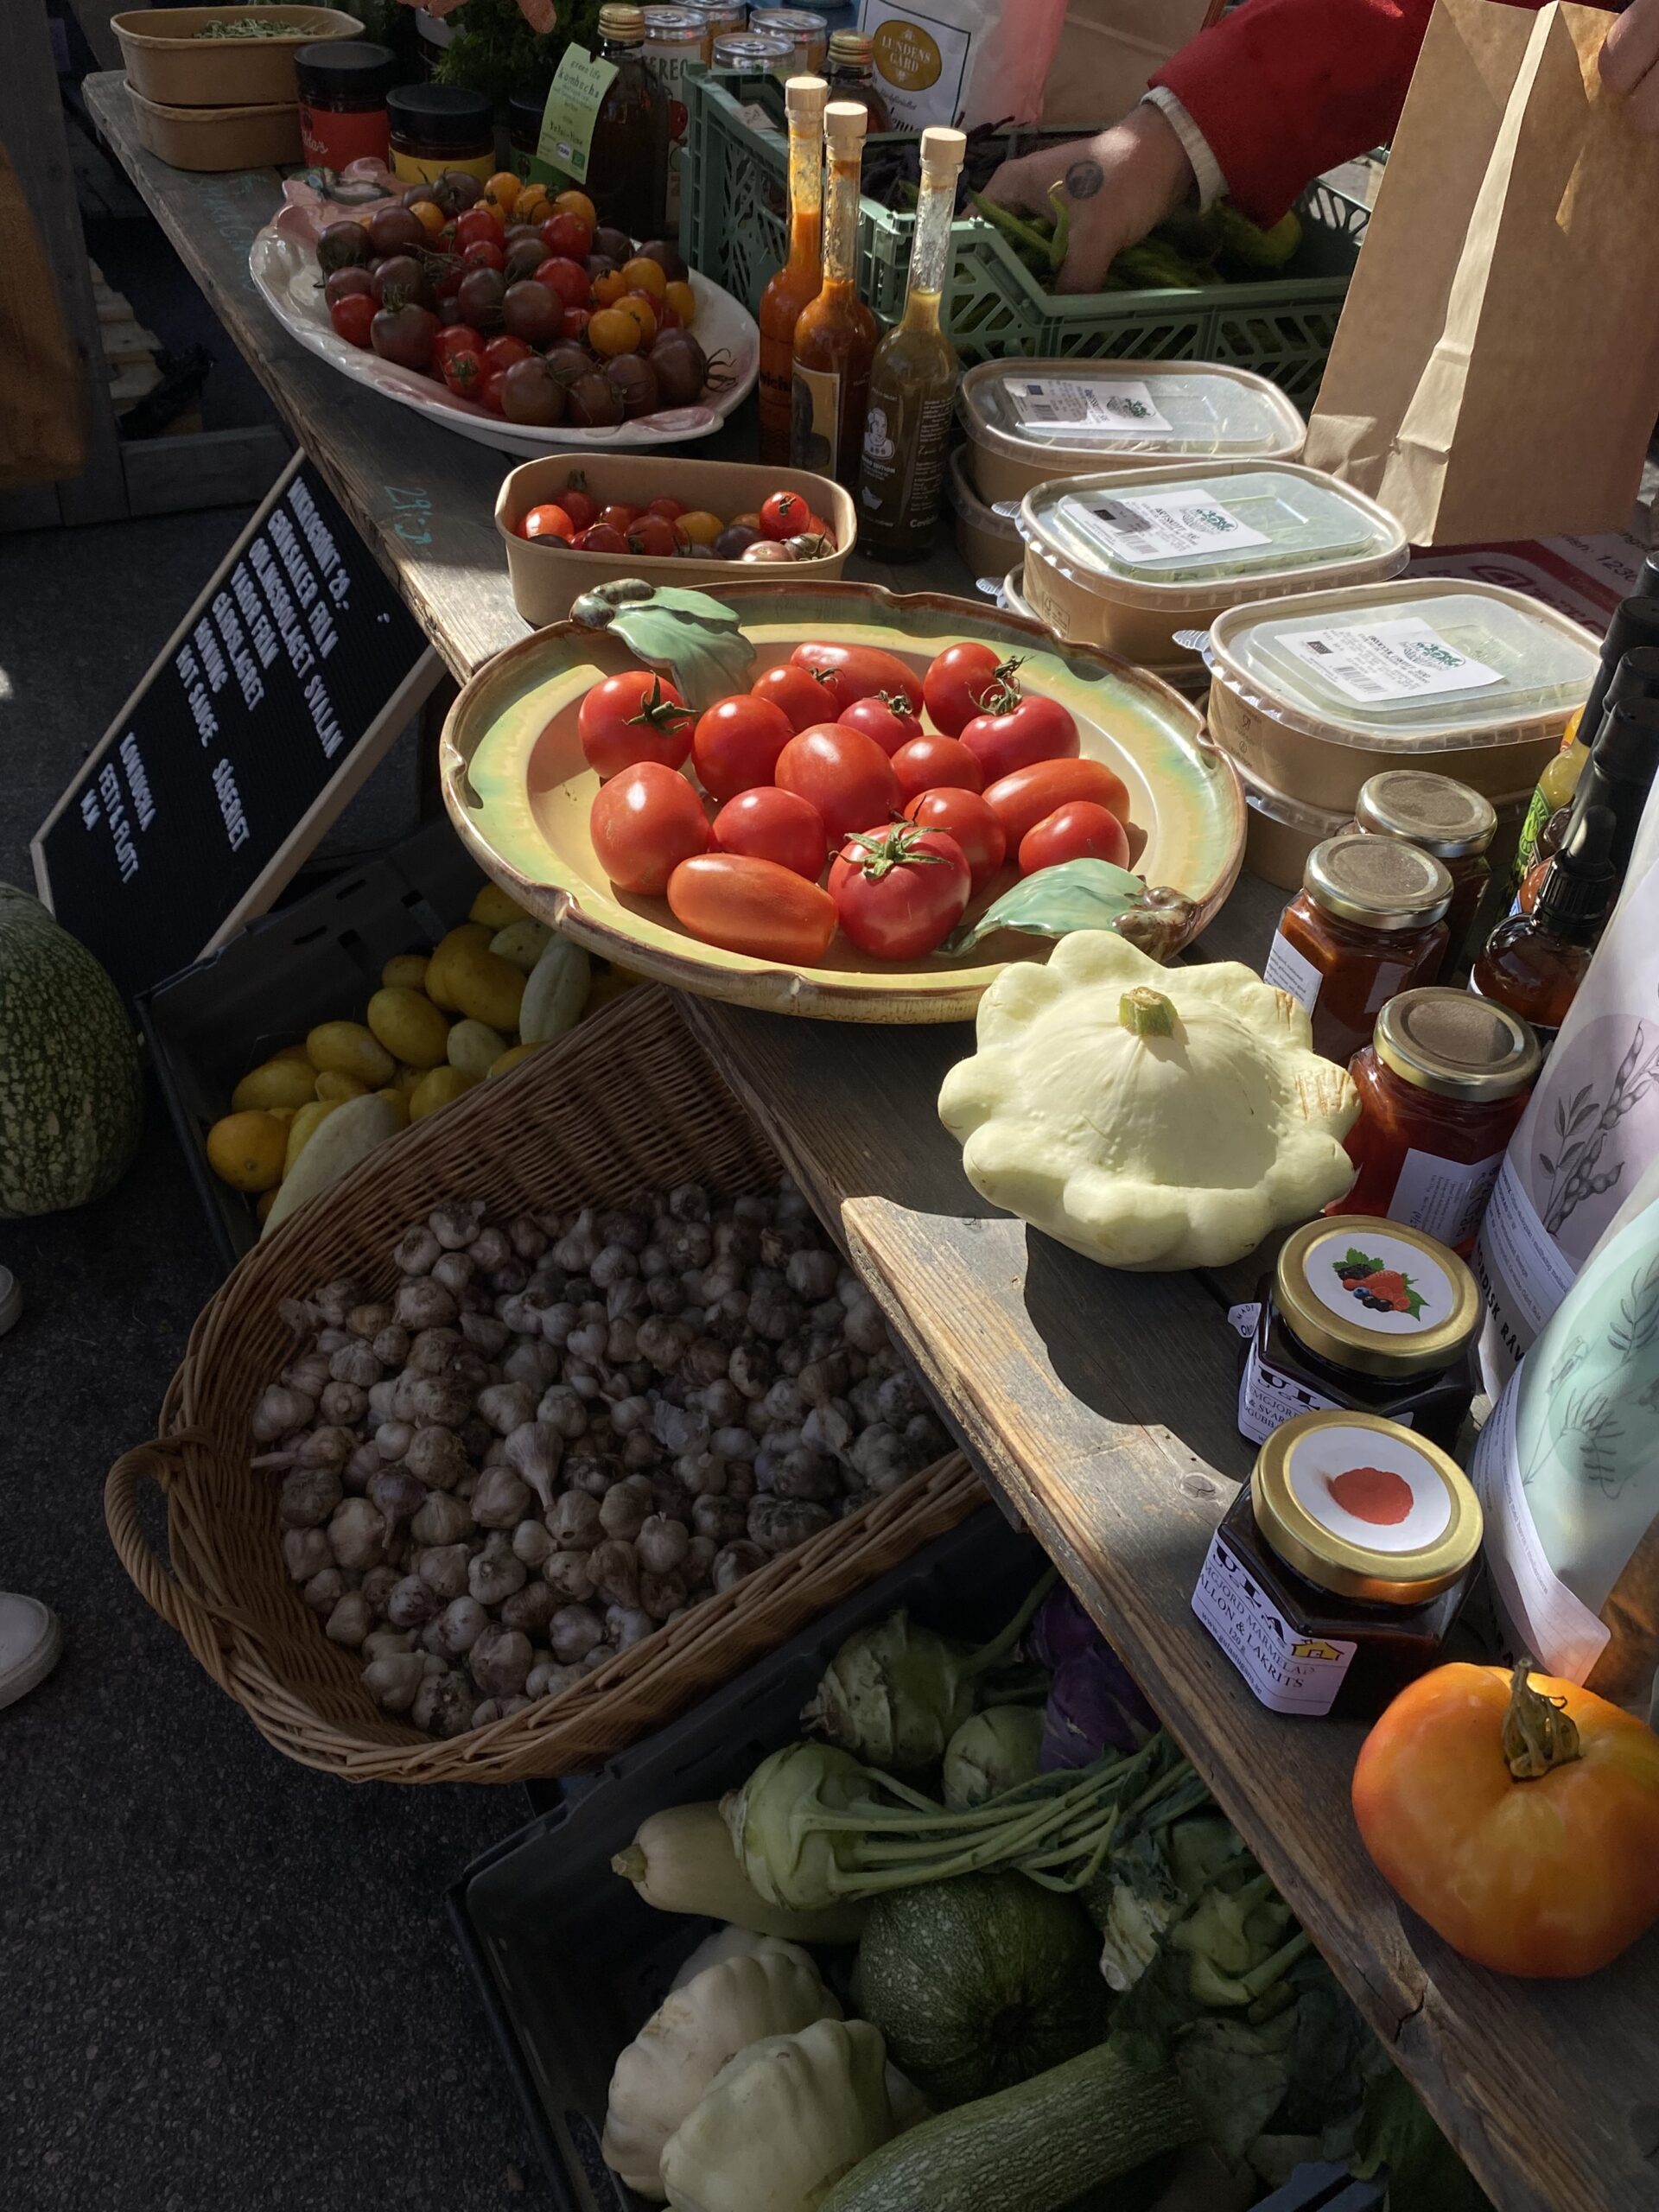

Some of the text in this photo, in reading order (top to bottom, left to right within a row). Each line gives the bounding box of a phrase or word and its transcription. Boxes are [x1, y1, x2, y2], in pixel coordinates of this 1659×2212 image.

[231, 563, 278, 668] VAROR FRÅN
[268, 510, 338, 658] GRÖNSAKER FRÅN
[176, 645, 199, 688] HOT
[188, 683, 218, 747] SAUCE
[194, 618, 227, 692] HONUNG
[249, 538, 343, 758] ODLINGSBOLAGET SVALAN
[120, 733, 155, 830] KOMBUCHA
[1229, 1629, 1242, 1645] 120
[1247, 1635, 1305, 1688] LAKRITS
